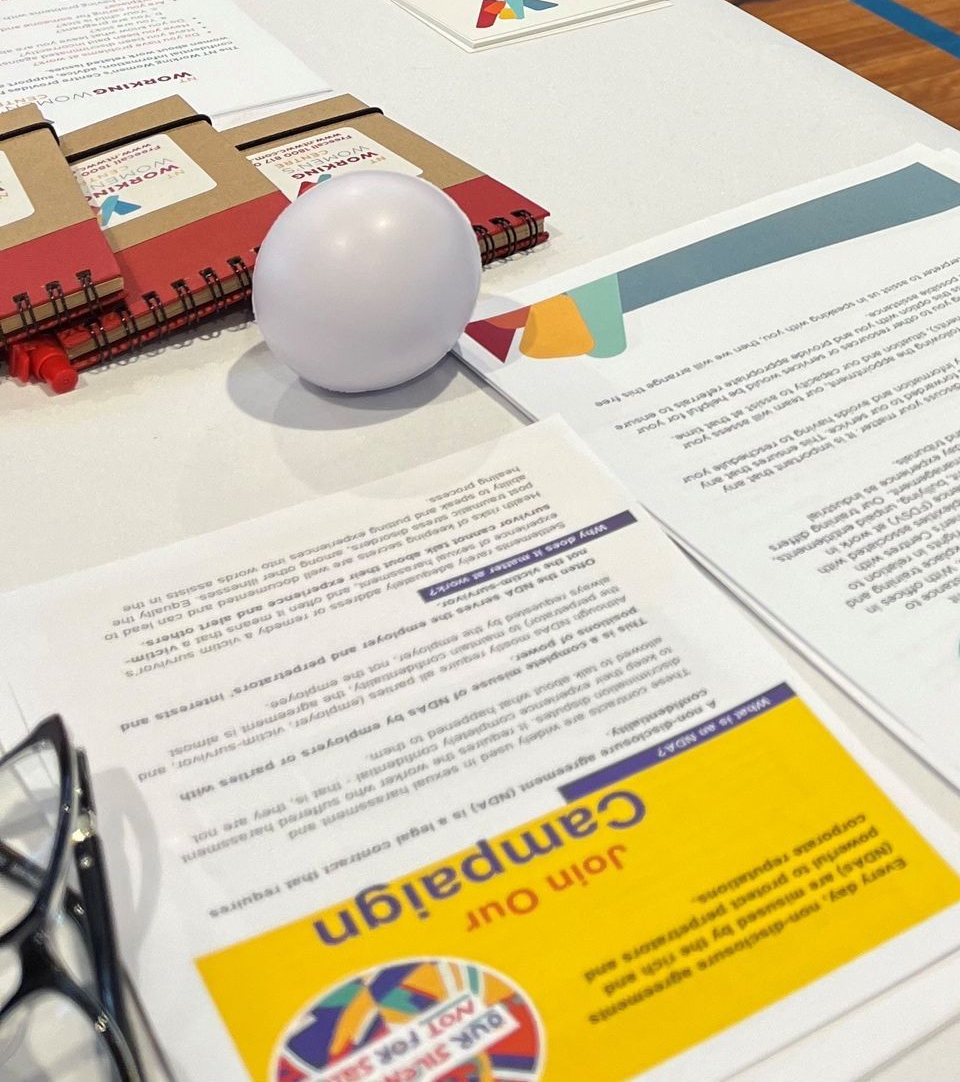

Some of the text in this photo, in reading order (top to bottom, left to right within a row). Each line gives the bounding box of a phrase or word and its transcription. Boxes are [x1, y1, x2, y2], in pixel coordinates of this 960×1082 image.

[190, 36, 227, 45] women
[48, 64, 83, 72] issues.
[86, 56, 125, 66] related
[103, 62, 154, 74] Women's
[155, 53, 200, 64] Working
[8, 80, 58, 91] provides
[36, 72, 190, 105] WORKING WOM
[62, 73, 100, 82] Centre
[284, 146, 308, 157] 1800
[311, 135, 352, 149] Freecall
[81, 145, 160, 177] Freecall 1800
[266, 156, 282, 164] 817
[276, 150, 328, 168] CENTRE
[282, 145, 368, 174] WOMEN'S
[292, 152, 378, 180] WORKING
[90, 158, 172, 190] WOMEN
[545, 536, 575, 550] does
[579, 524, 606, 538] Why
[142, 504, 549, 645] survivor cannot talk about their experience and alert others.
[472, 571, 484, 579] at
[490, 554, 529, 572] matter
[430, 577, 468, 595] work?
[612, 690, 706, 734] confidentiality.
[706, 700, 715, 708] A
[600, 707, 702, 755] non-disclosure
[658, 698, 769, 756] What is an NDA?
[520, 754, 595, 791] agreement
[470, 788, 515, 812] (NDA)
[452, 809, 466, 818] is
[396, 823, 434, 844] legal
[313, 790, 646, 946] Campaign
[324, 841, 390, 873] contract
[692, 815, 864, 902] corporate reputations.
[286, 871, 318, 888] that
[466, 844, 626, 932] Join Our
[209, 886, 279, 916] requires
[584, 827, 877, 981] powerful to protect perpetrators and
[604, 843, 891, 994] (NDAs) are misused by the rich and
[589, 858, 906, 1022] Every day, non-disclosure agreements
[426, 1000, 475, 1038] NOT
[450, 1013, 503, 1050] OUR
[374, 1030, 420, 1064] FOR
